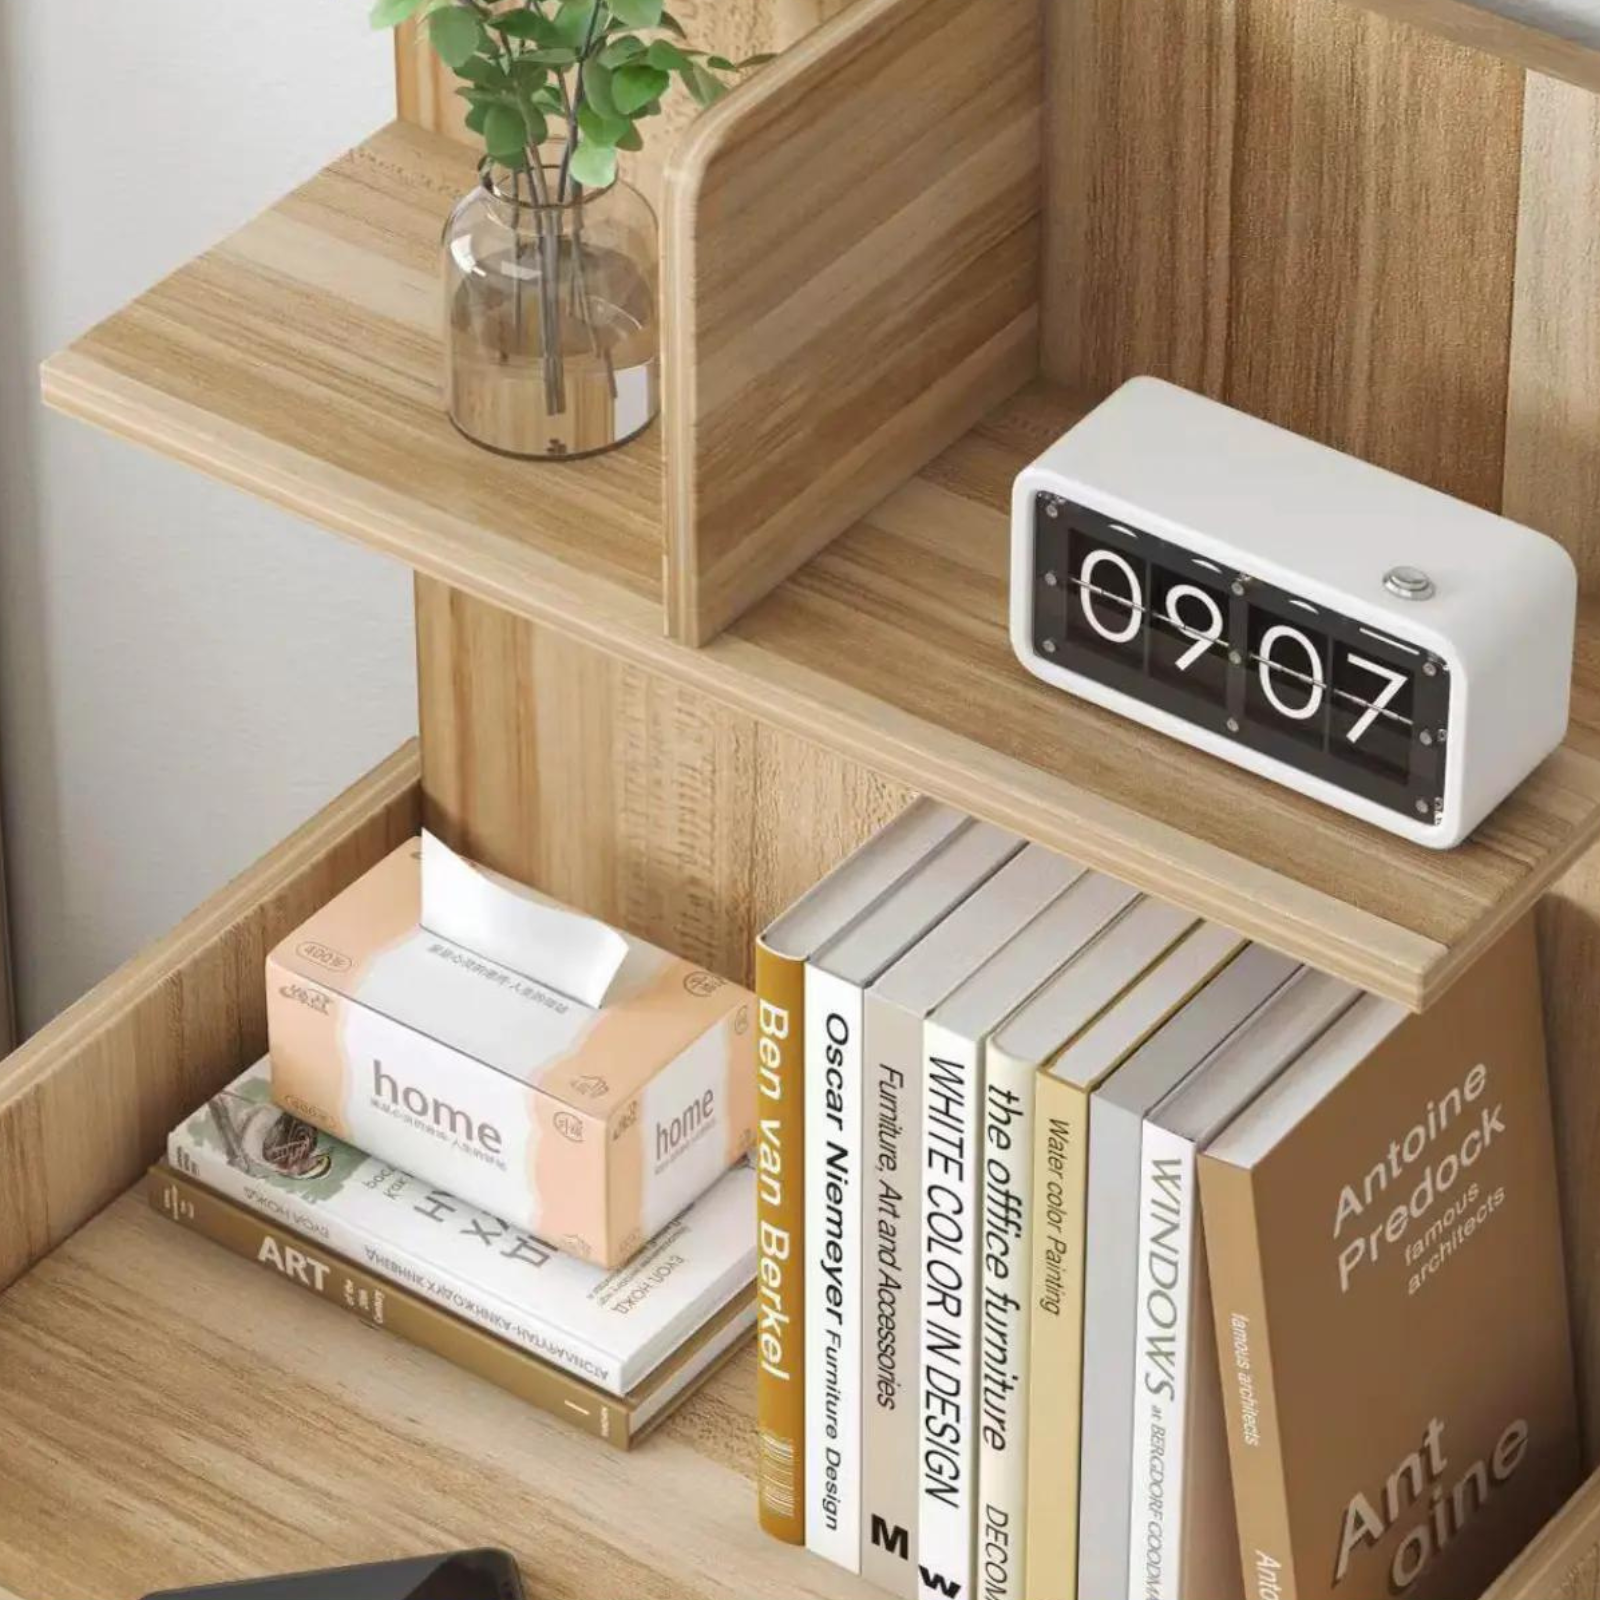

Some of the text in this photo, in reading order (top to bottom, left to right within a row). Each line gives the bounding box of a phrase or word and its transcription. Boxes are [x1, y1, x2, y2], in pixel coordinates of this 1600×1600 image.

[373, 1060, 503, 1153] home
[655, 1088, 714, 1160] home
[760, 998, 790, 1380] Ben van Berkel
[988, 1084, 1024, 1151] the
[1333, 1062, 1487, 1240] Antoine
[258, 1236, 331, 1292] ART
[820, 1013, 849, 1532] Oscar Niemeyer Furniture Design
[874, 1063, 904, 1411] Furniture, Art and Accessories
[1039, 1236, 1067, 1316] Painting
[1144, 1158, 1182, 1402] WINDOWS
[1338, 1102, 1507, 1294] Predock
[1404, 1182, 1480, 1267] famous
[1408, 1185, 1506, 1295] architects
[924, 1056, 965, 1509] WHITE COLOR IN DESIGN
[983, 1285, 1020, 1452] furniture
[1230, 1312, 1261, 1447] famous architects
[1334, 1416, 1449, 1584] Ant
[1390, 1418, 1529, 1589] oine
